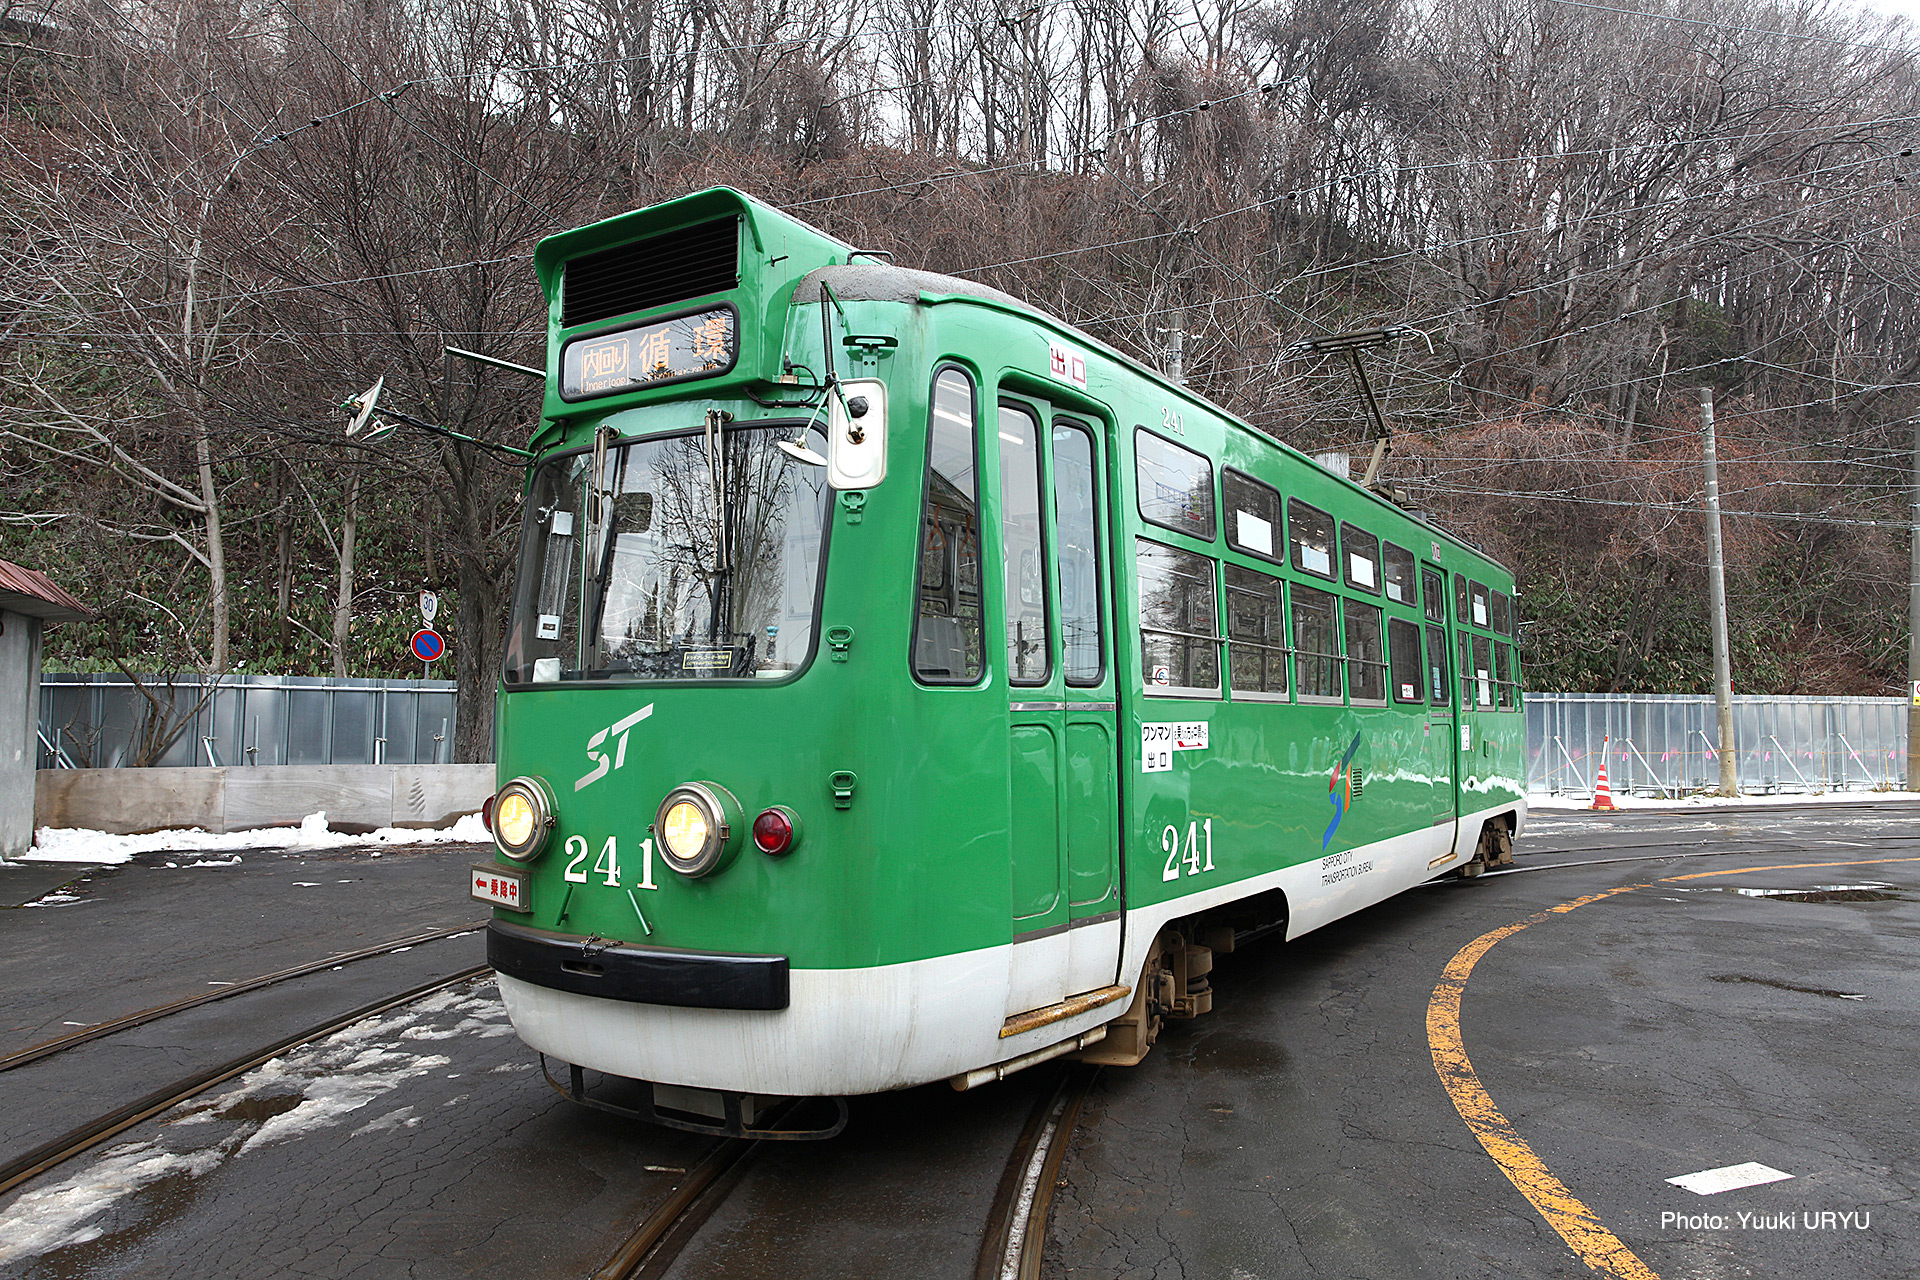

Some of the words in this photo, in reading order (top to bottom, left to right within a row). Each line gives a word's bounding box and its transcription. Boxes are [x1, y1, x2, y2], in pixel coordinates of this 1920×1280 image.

[584, 343, 627, 379] 内回り
[1051, 348, 1086, 384] 出口
[585, 380, 608, 392] Inner
[1161, 405, 1185, 436] 241
[423, 596, 434, 612] 30
[575, 702, 654, 792] ST
[1143, 726, 1171, 742] ワンマン
[1148, 752, 1167, 769] 出口
[564, 834, 658, 890] 241
[1162, 818, 1216, 882] 241
[1322, 853, 1343, 870] SAPPORO
[1343, 851, 1354, 864] CITY
[1322, 866, 1358, 887] TRANSPORTATION
[1358, 860, 1374, 875] BUREAU
[491, 878, 517, 901] 乗降中
